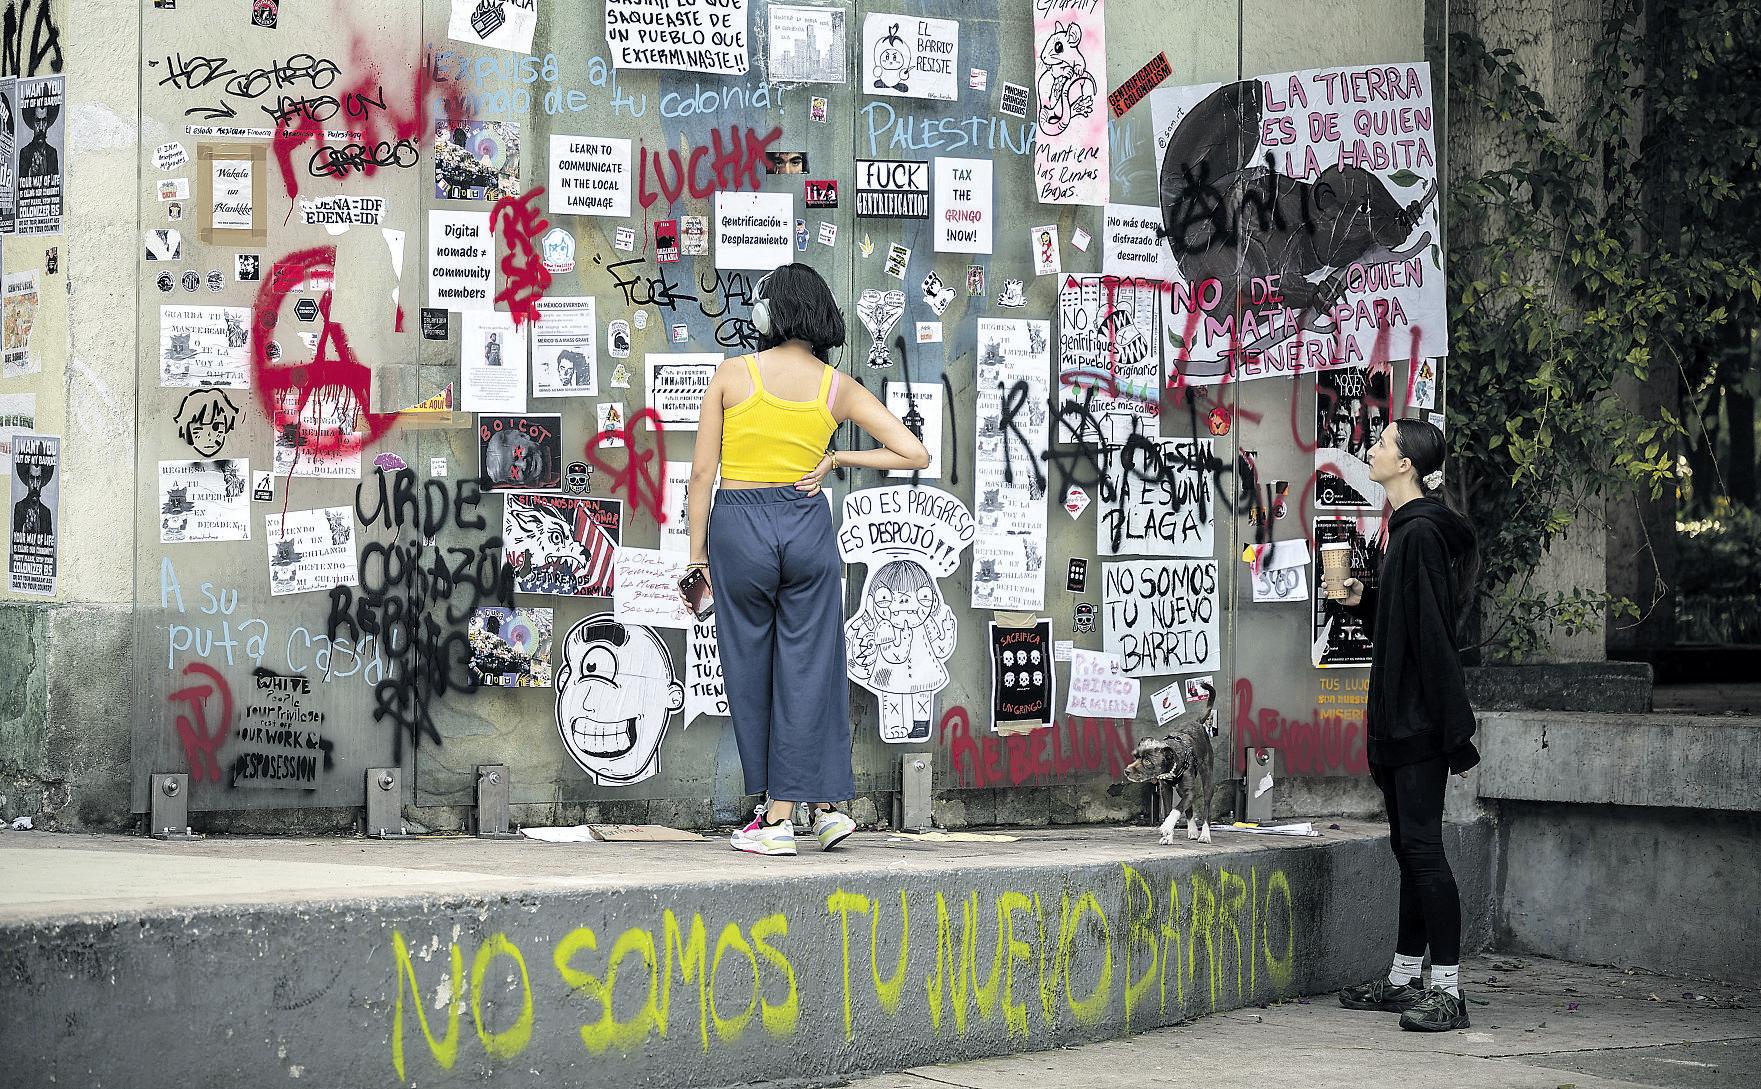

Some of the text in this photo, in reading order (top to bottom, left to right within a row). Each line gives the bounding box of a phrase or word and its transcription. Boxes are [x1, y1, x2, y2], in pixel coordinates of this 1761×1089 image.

[608, 10, 731, 27] SAQUEASTE DE
[918, 21, 931, 36] EL
[609, 29, 745, 47] UN PUEBLO QUE
[622, 47, 747, 73] EXTERMINASTE!!
[916, 57, 952, 74] RESISTE
[25, 79, 62, 97] WANT YOU
[1108, 52, 1166, 107] GENTRIFICATION
[1005, 85, 1028, 99] PINCHES
[1115, 63, 1172, 117] IS COLONIALISM
[1264, 67, 1422, 112] LA TIERRA
[545, 86, 590, 115] de
[610, 86, 646, 117] tu
[1002, 102, 1025, 115] CULEROS
[1261, 107, 1432, 146] ES DE QUIEN
[570, 143, 612, 156] LEARN TO
[559, 161, 622, 173] COMMUNICATE
[1286, 138, 1433, 180] LA HABITA
[19, 177, 32, 188] YOUR
[44, 176, 51, 186] OF
[51, 175, 60, 186] LIFE
[952, 169, 972, 181] TAX
[561, 178, 619, 190] IN THE LOCAL
[567, 195, 614, 209] LANGUAGE
[807, 186, 836, 201] liza
[953, 189, 971, 201] THE
[19, 205, 50, 219] COLONIZER
[857, 192, 928, 216] GENTRIFICATION
[722, 215, 781, 229] Gentrificación
[945, 209, 981, 223] GRINGO
[1107, 216, 1138, 228] ¡No más
[445, 224, 479, 238] Digital
[721, 233, 788, 246] Desplazamiento
[947, 229, 977, 242] !NOW!
[1112, 234, 1152, 246] disfrazado
[437, 245, 478, 257] nomads
[1117, 251, 1158, 263] desarrollo!
[432, 265, 491, 282] community
[438, 286, 486, 299] members
[1171, 258, 1422, 314] NO DE QUIEN
[1063, 308, 1087, 330] NO
[1205, 297, 1408, 348] MATA PARA
[1061, 330, 1119, 355] gentrifiques
[1217, 335, 1363, 376] TENERLA
[1079, 353, 1113, 371] pueblo
[1114, 364, 1159, 378] originario
[1118, 401, 1134, 411] mis
[19, 440, 57, 455] WANT YOU
[846, 489, 975, 541] NO ES PROGRESO
[1101, 509, 1202, 544] PLAGA
[37, 533, 43, 545] OF
[43, 535, 54, 546] LIFE
[840, 525, 864, 554] ES
[13, 561, 42, 575] COLONIZER
[160, 557, 238, 615] A su
[1107, 566, 1134, 598] NO
[1138, 563, 1216, 599] SOMOS
[1105, 595, 1212, 631] TU NUEVO
[169, 619, 269, 669] puta
[1001, 632, 1041, 646] SACRIFICA
[1119, 630, 1209, 672] BARRIO
[1320, 678, 1340, 691] TUS
[1002, 700, 1042, 715] UN GRINGO
[266, 729, 302, 748] WORK
[392, 860, 1294, 1083] NO SOMOS TU NUEVO BARRIO
